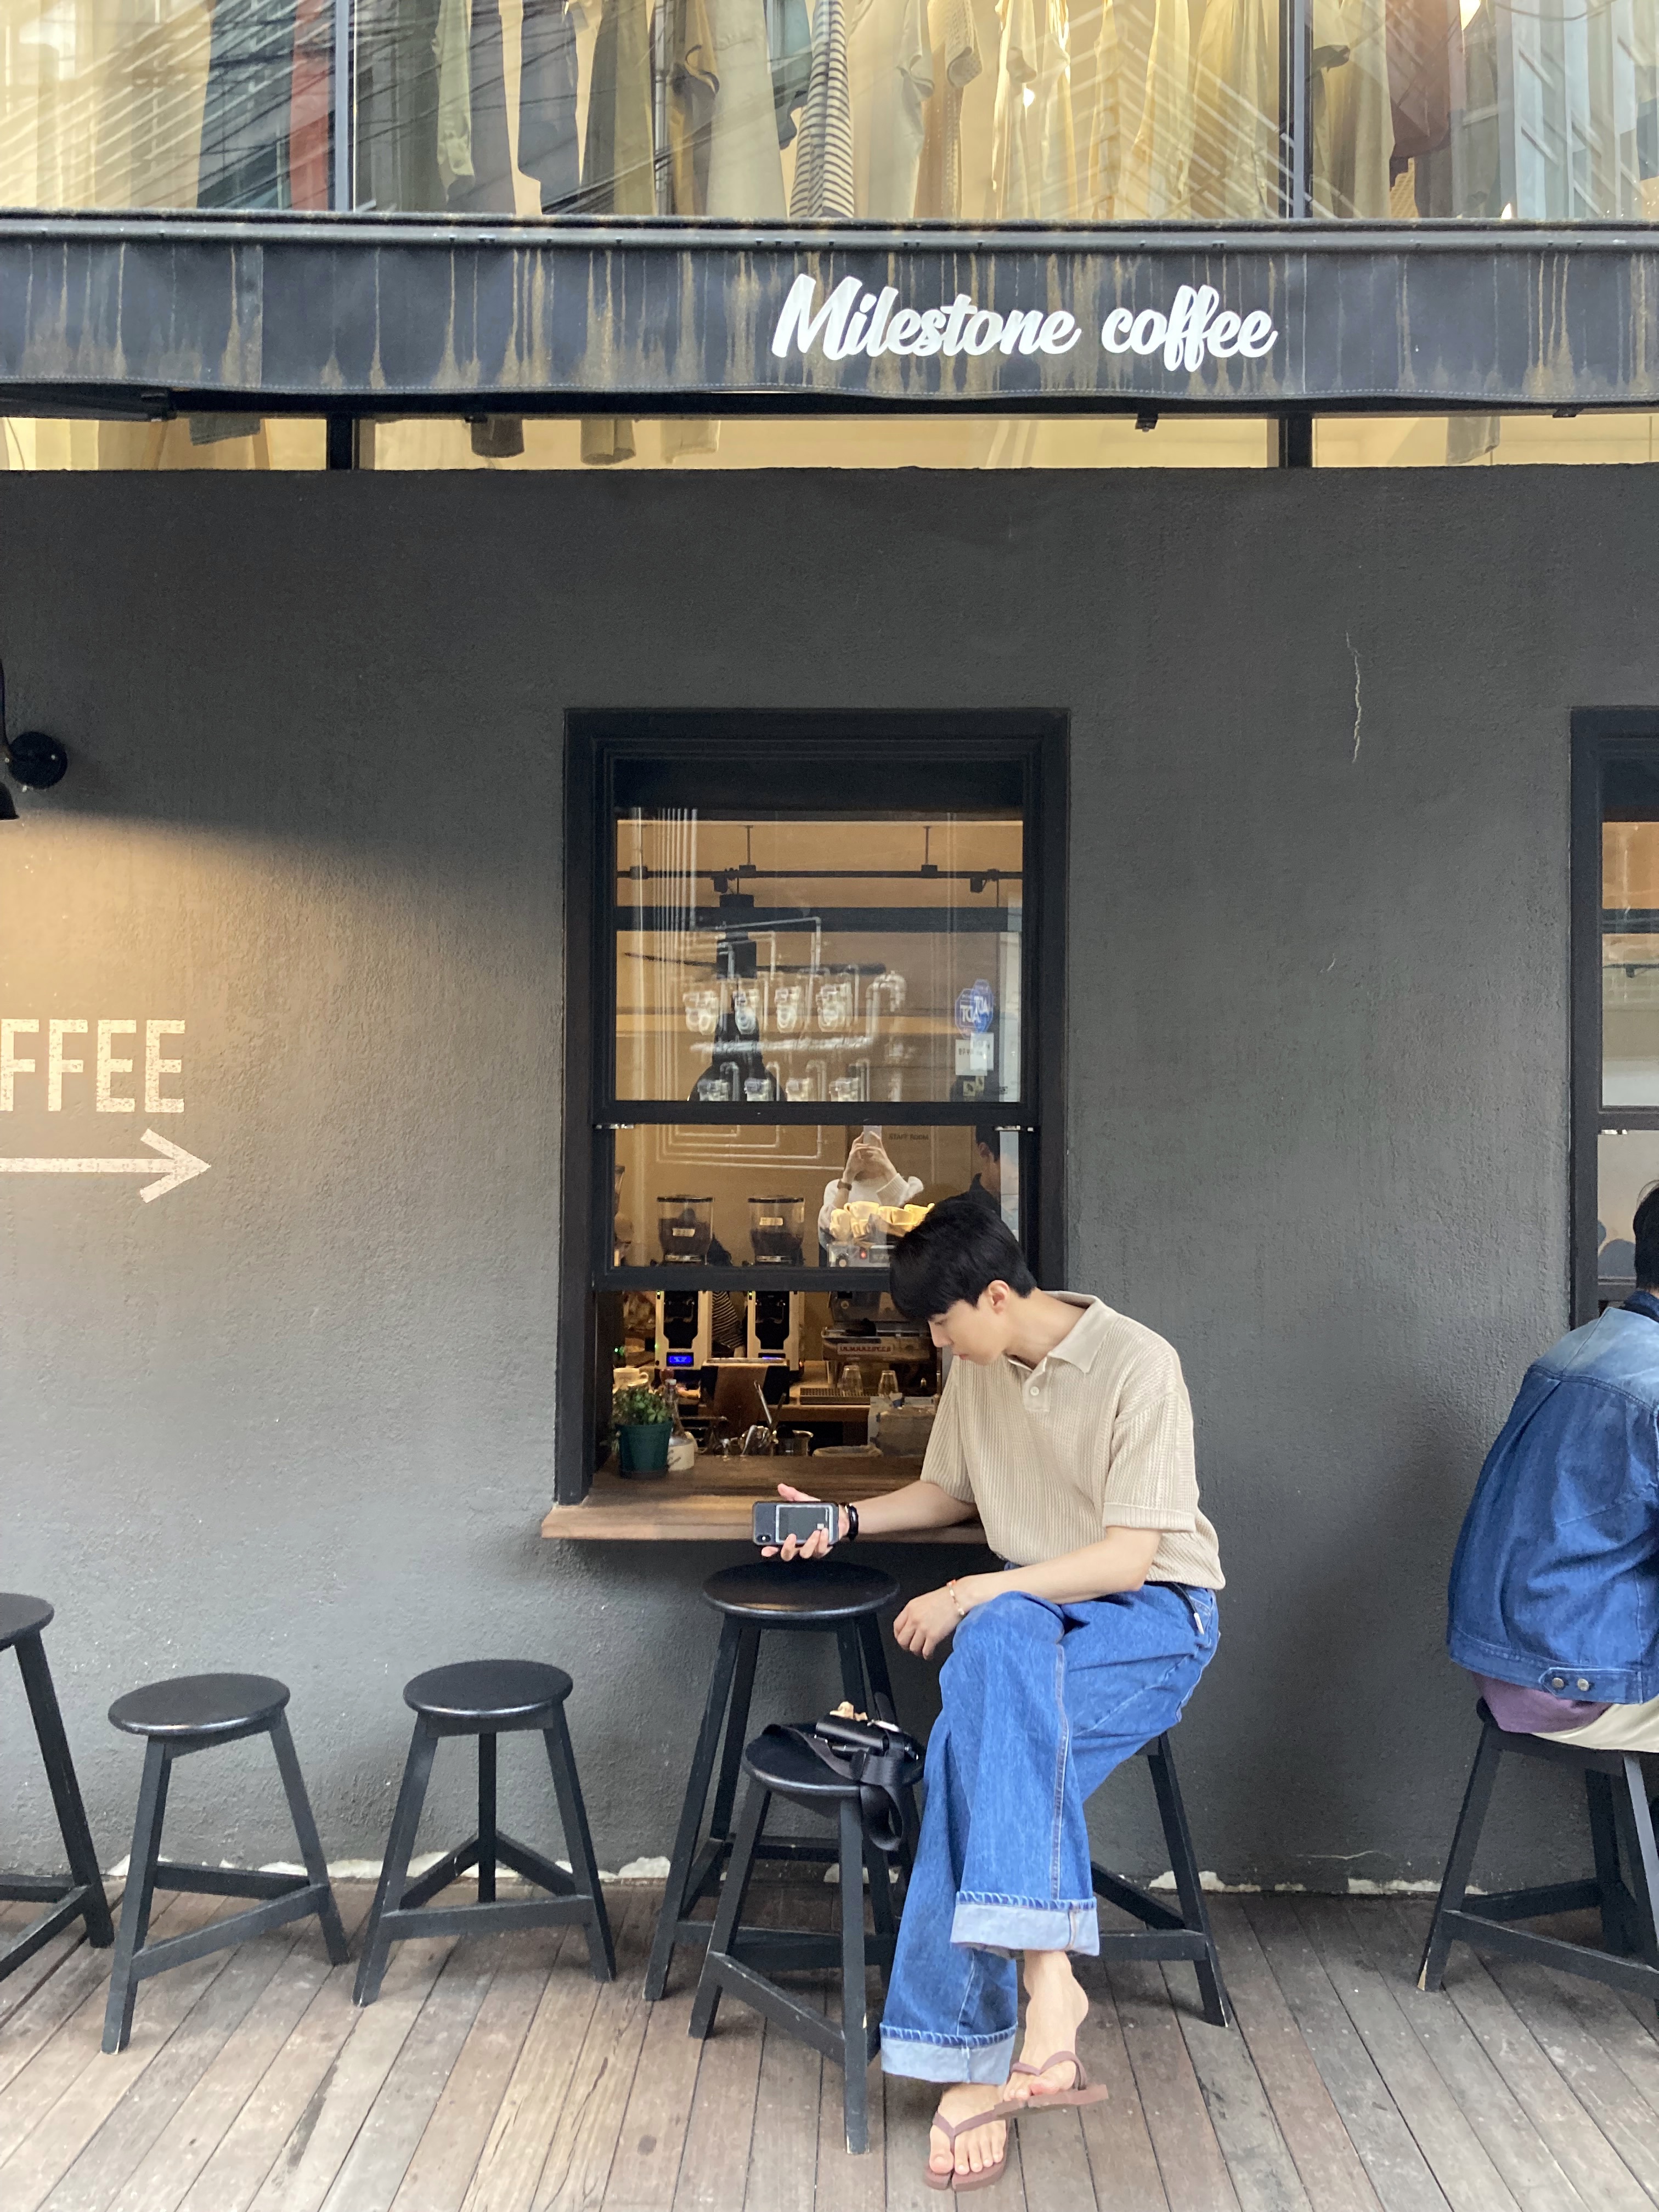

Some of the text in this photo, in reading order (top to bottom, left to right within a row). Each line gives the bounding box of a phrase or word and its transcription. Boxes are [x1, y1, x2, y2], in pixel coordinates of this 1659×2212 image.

[771, 273, 1277, 372] Milestone coffee
[0, 1019, 185, 1113] FFEE
